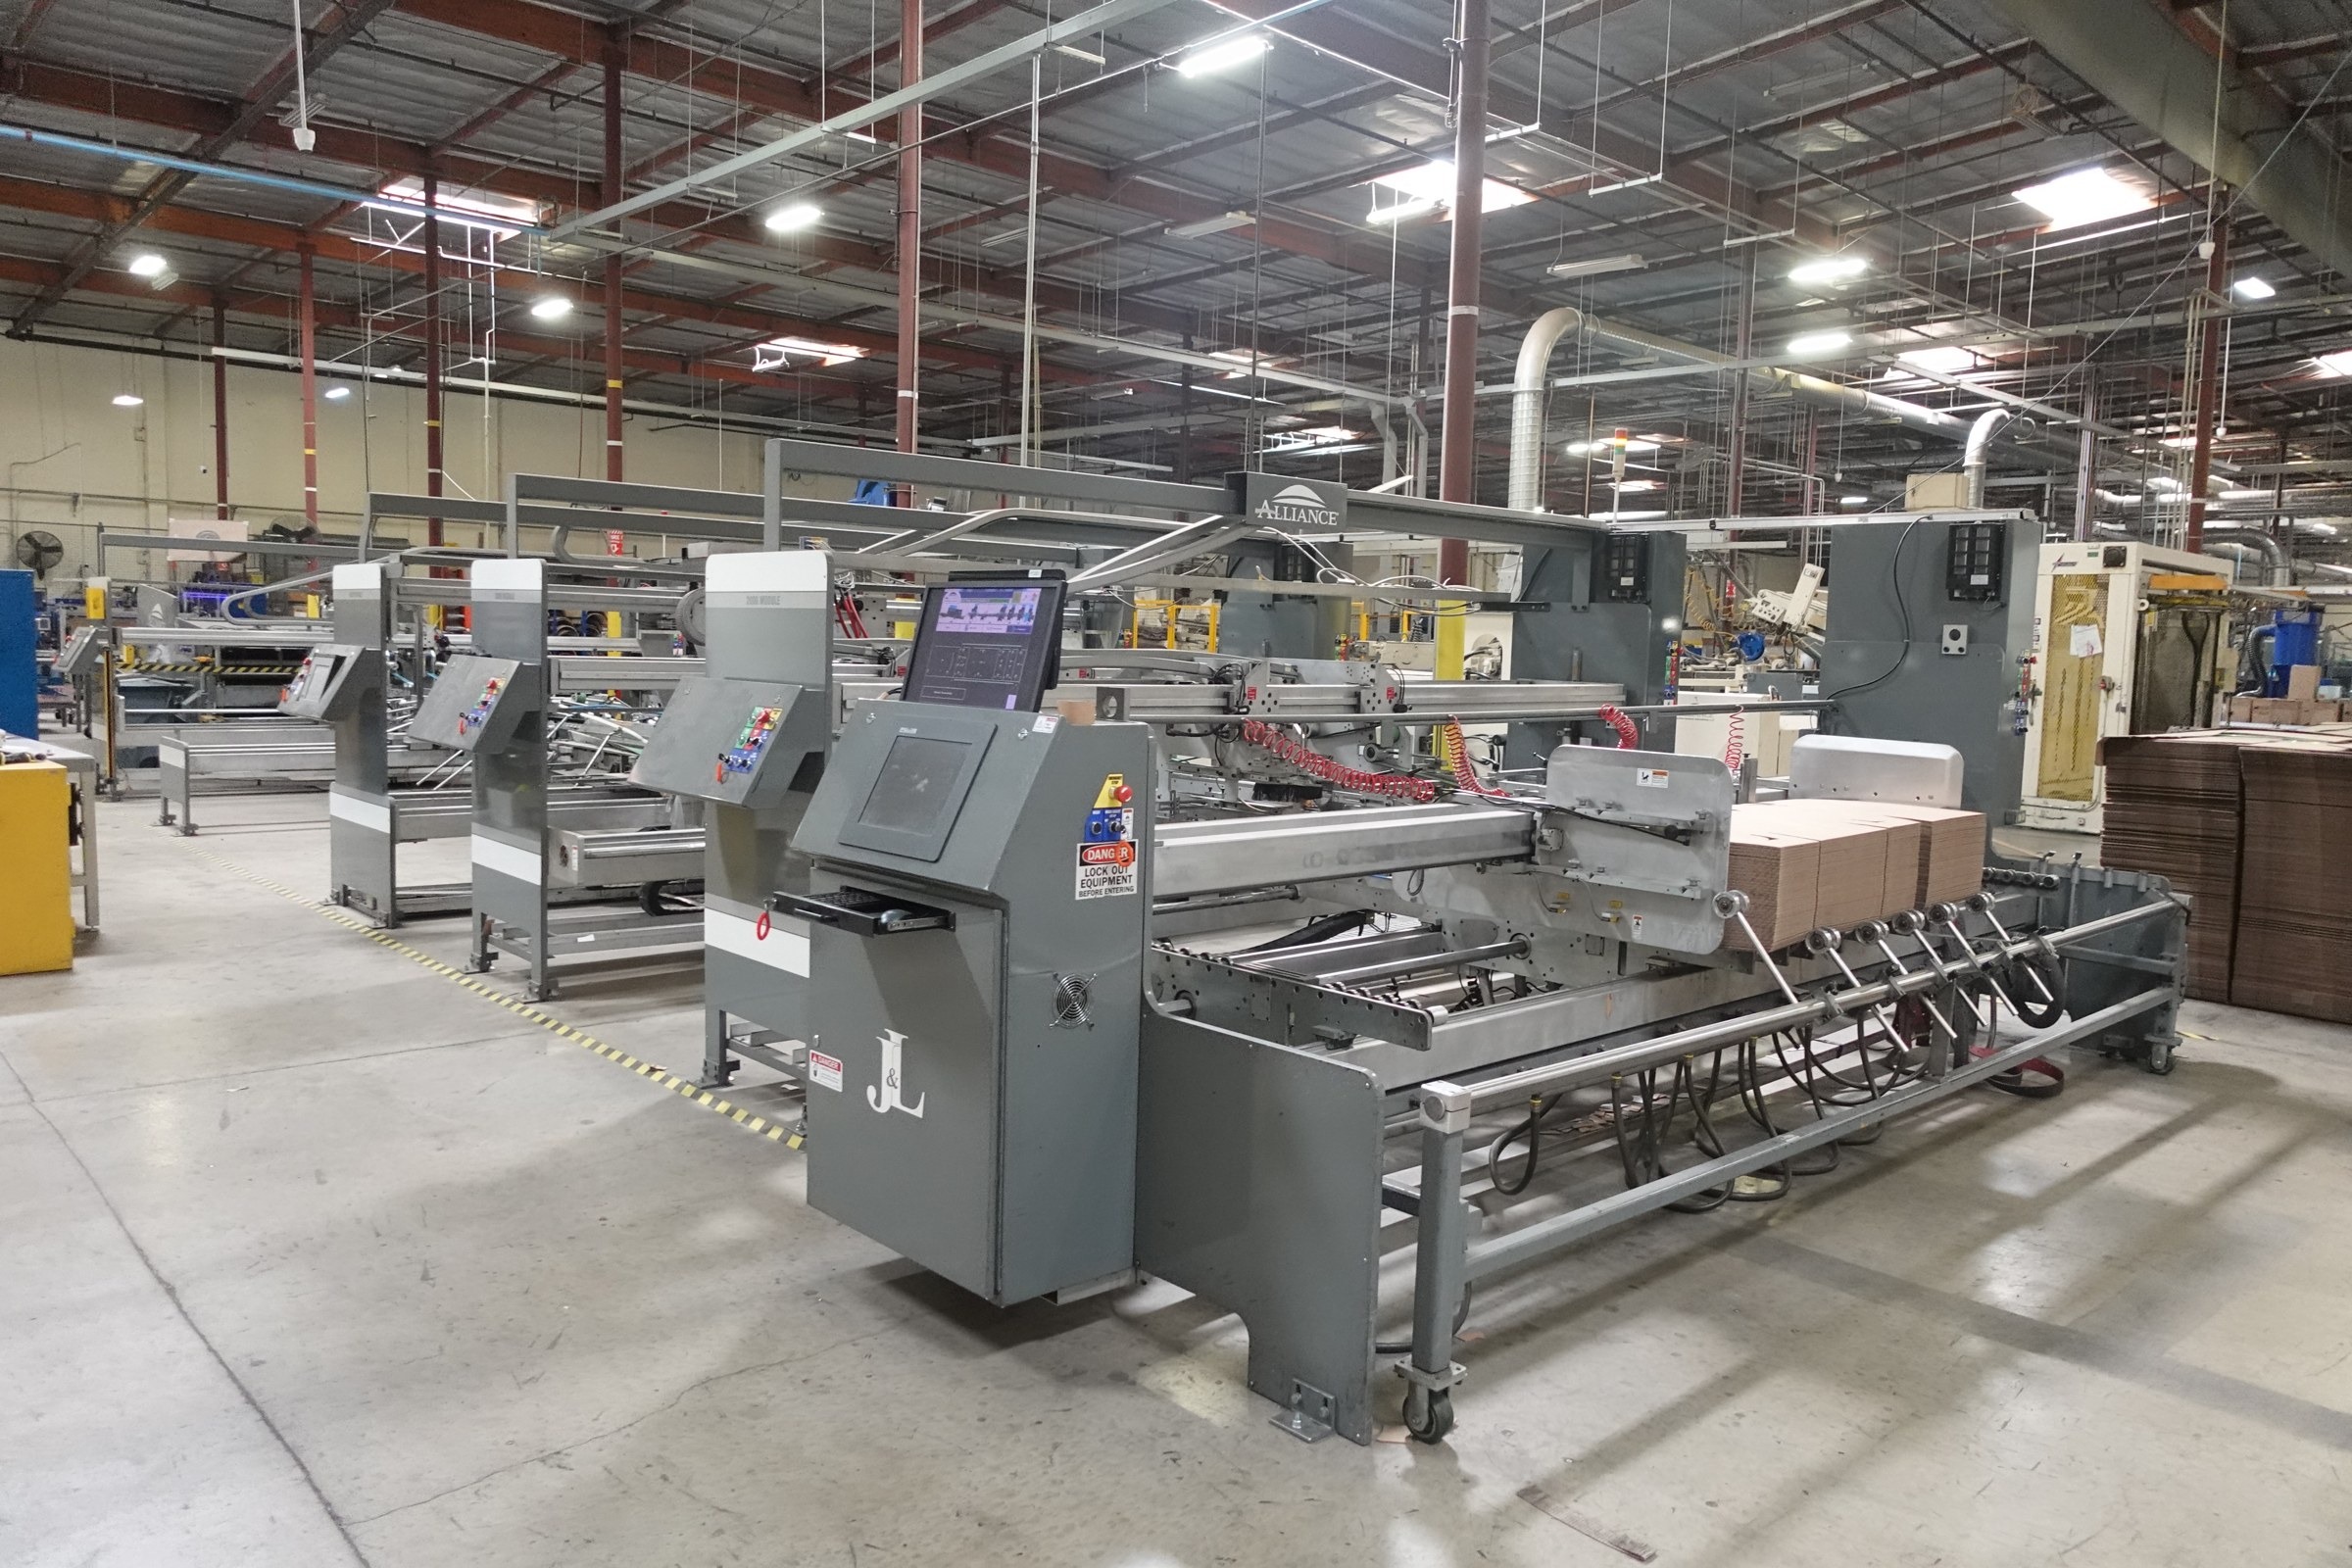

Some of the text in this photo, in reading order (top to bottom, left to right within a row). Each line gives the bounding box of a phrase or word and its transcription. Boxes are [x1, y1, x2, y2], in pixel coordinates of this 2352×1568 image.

[1255, 500, 1339, 526] ALLIANCE
[1088, 847, 1129, 860] DANGR
[1085, 866, 1108, 878] LOCK
[1081, 875, 1133, 889] EQUIPMENT
[1078, 885, 1135, 898] BEFORE ENTERING
